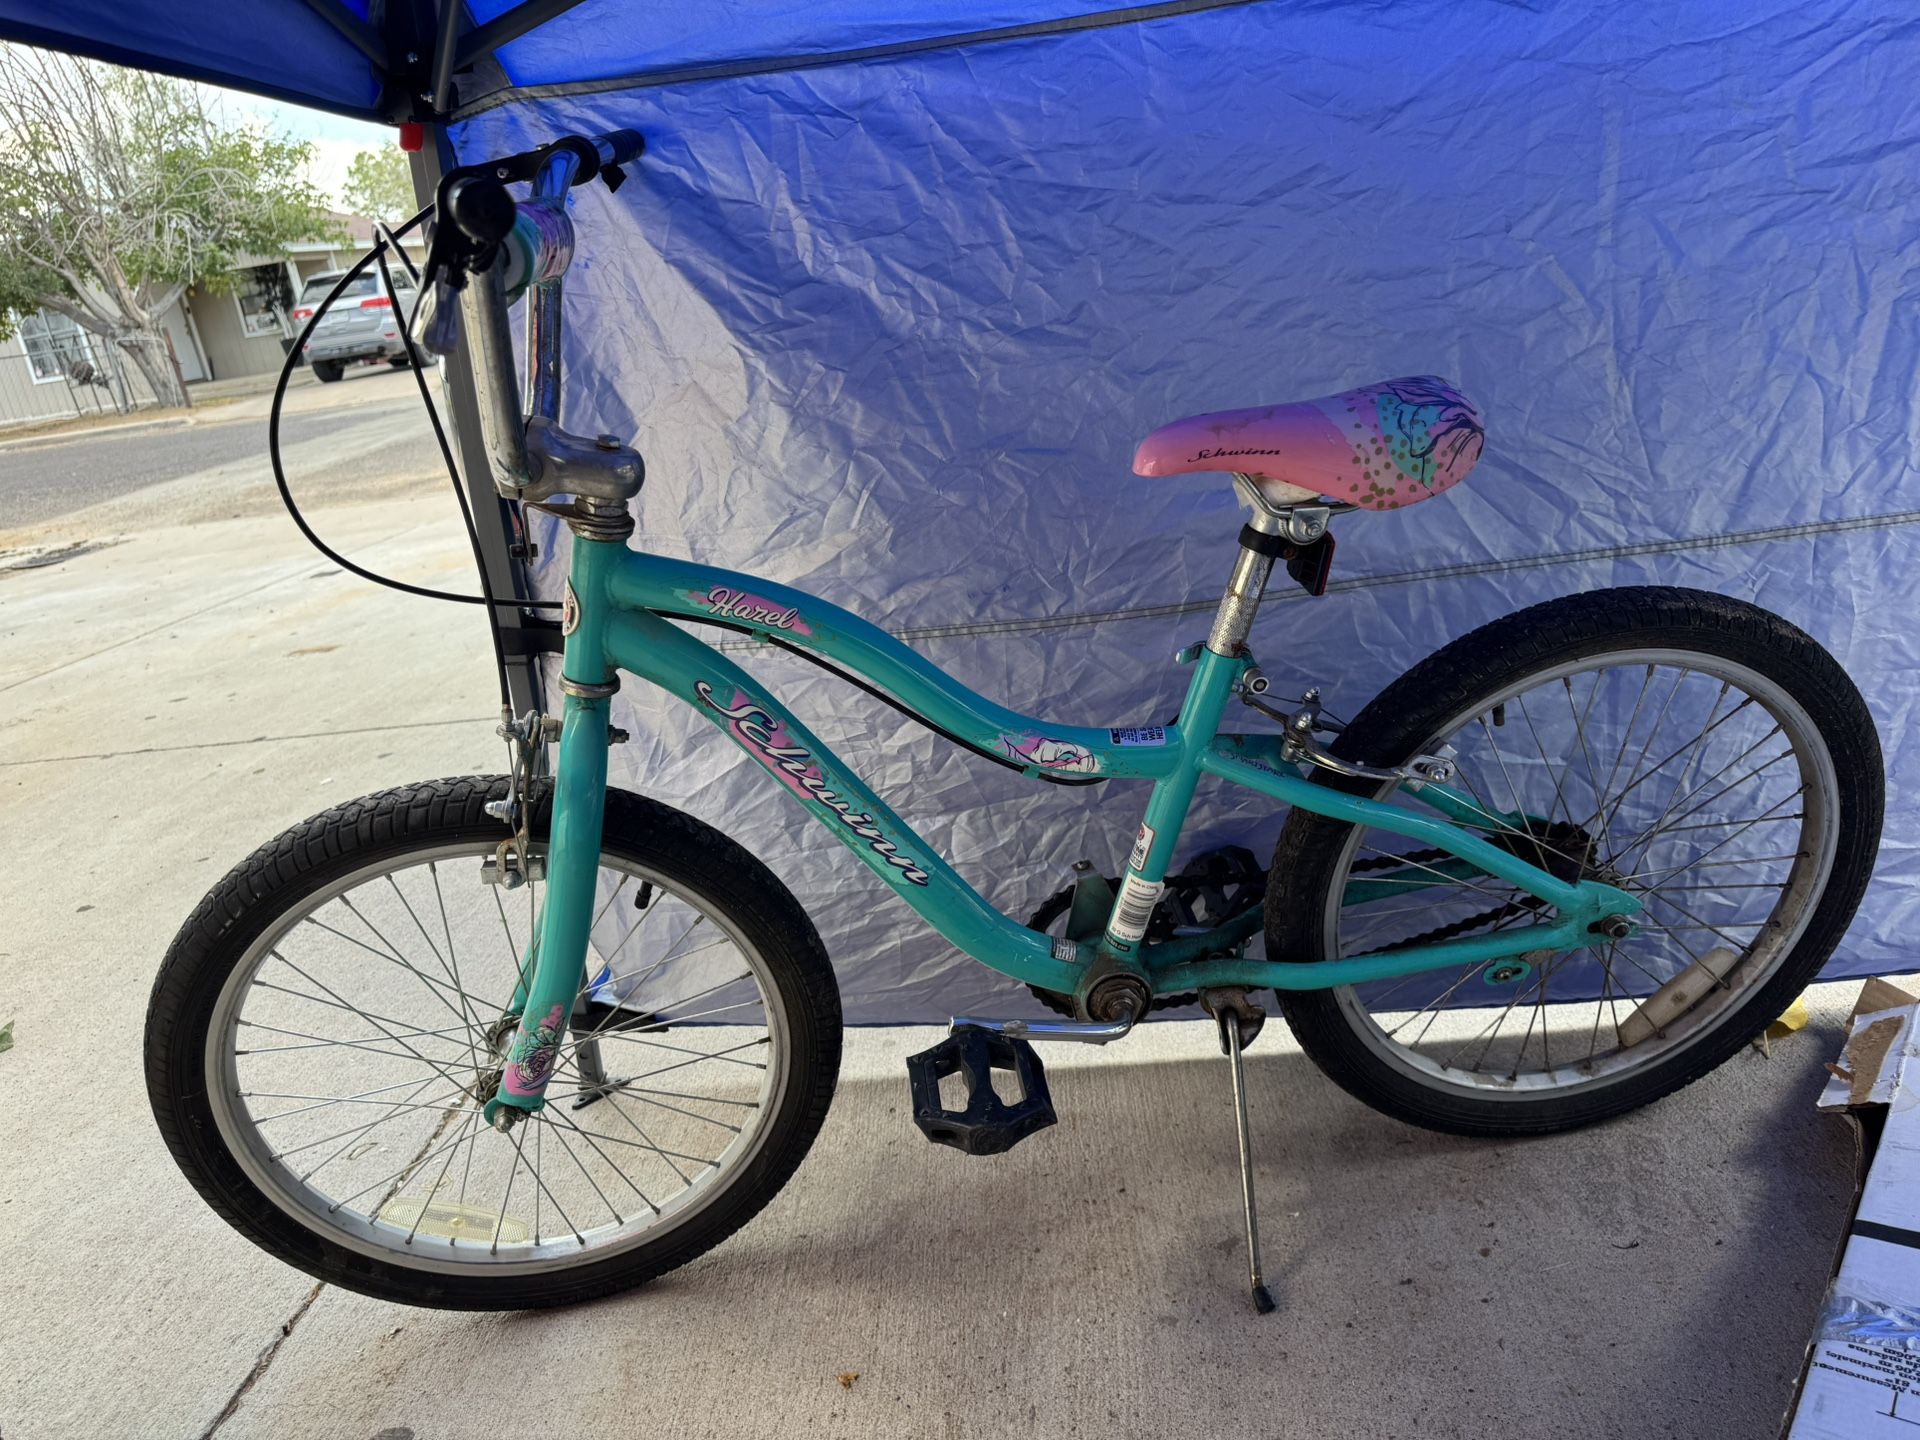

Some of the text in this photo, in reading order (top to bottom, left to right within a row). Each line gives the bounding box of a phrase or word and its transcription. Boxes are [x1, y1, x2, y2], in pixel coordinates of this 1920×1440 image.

[1187, 447, 1281, 463] Schwinn
[707, 587, 799, 630] Hazel
[693, 680, 929, 887] Schwinn
[1811, 1362, 1906, 1393] Measurement
[1825, 1350, 1896, 1375] maximales
